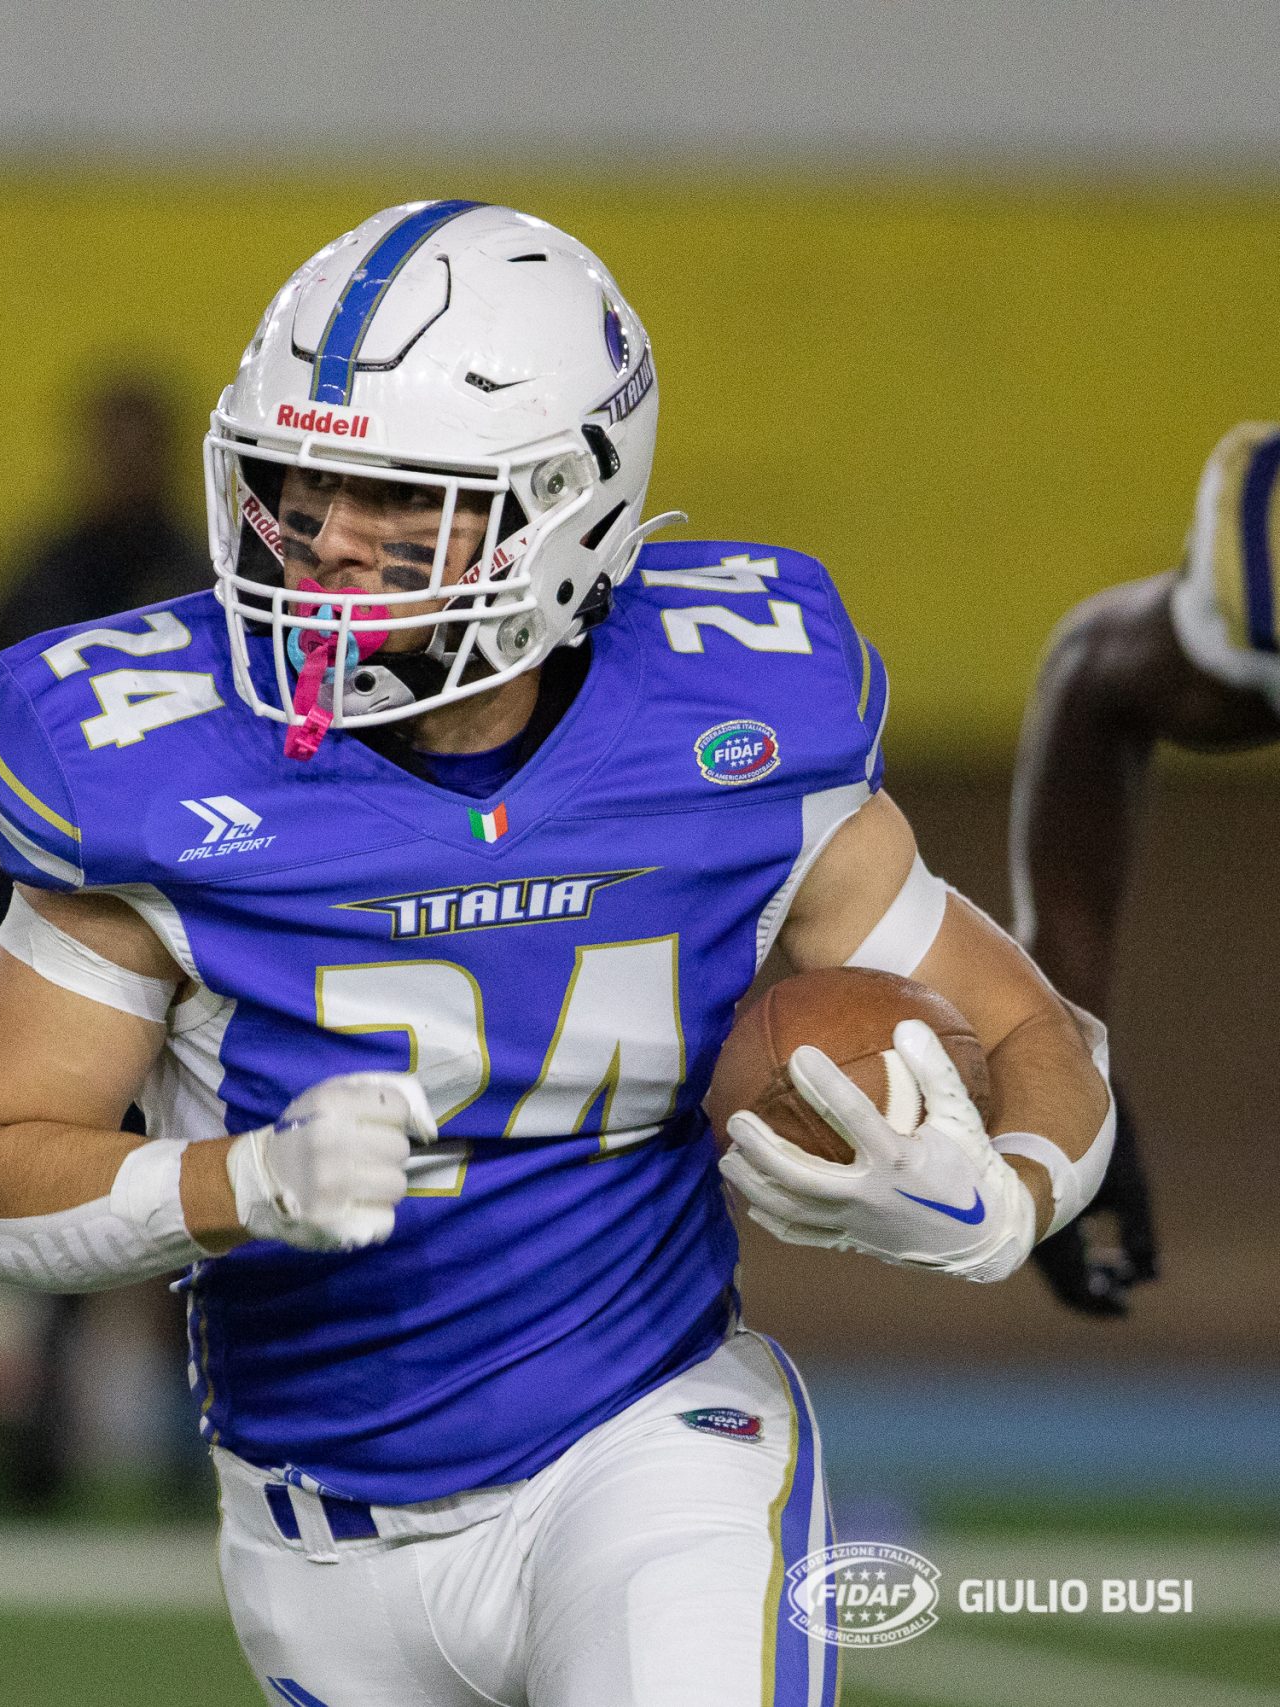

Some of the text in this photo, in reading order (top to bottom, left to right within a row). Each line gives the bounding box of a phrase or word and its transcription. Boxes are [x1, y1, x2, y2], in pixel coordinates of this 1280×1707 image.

[277, 404, 369, 438] Riddell
[638, 554, 813, 654] 24
[40, 611, 225, 750] 24
[700, 723, 772, 749] FEDERAZIONE ITALIANA
[714, 742, 763, 763] FIDAF
[714, 770, 748, 781] AMERICAN
[383, 878, 607, 936] ITALIA
[315, 933, 686, 1198] 24
